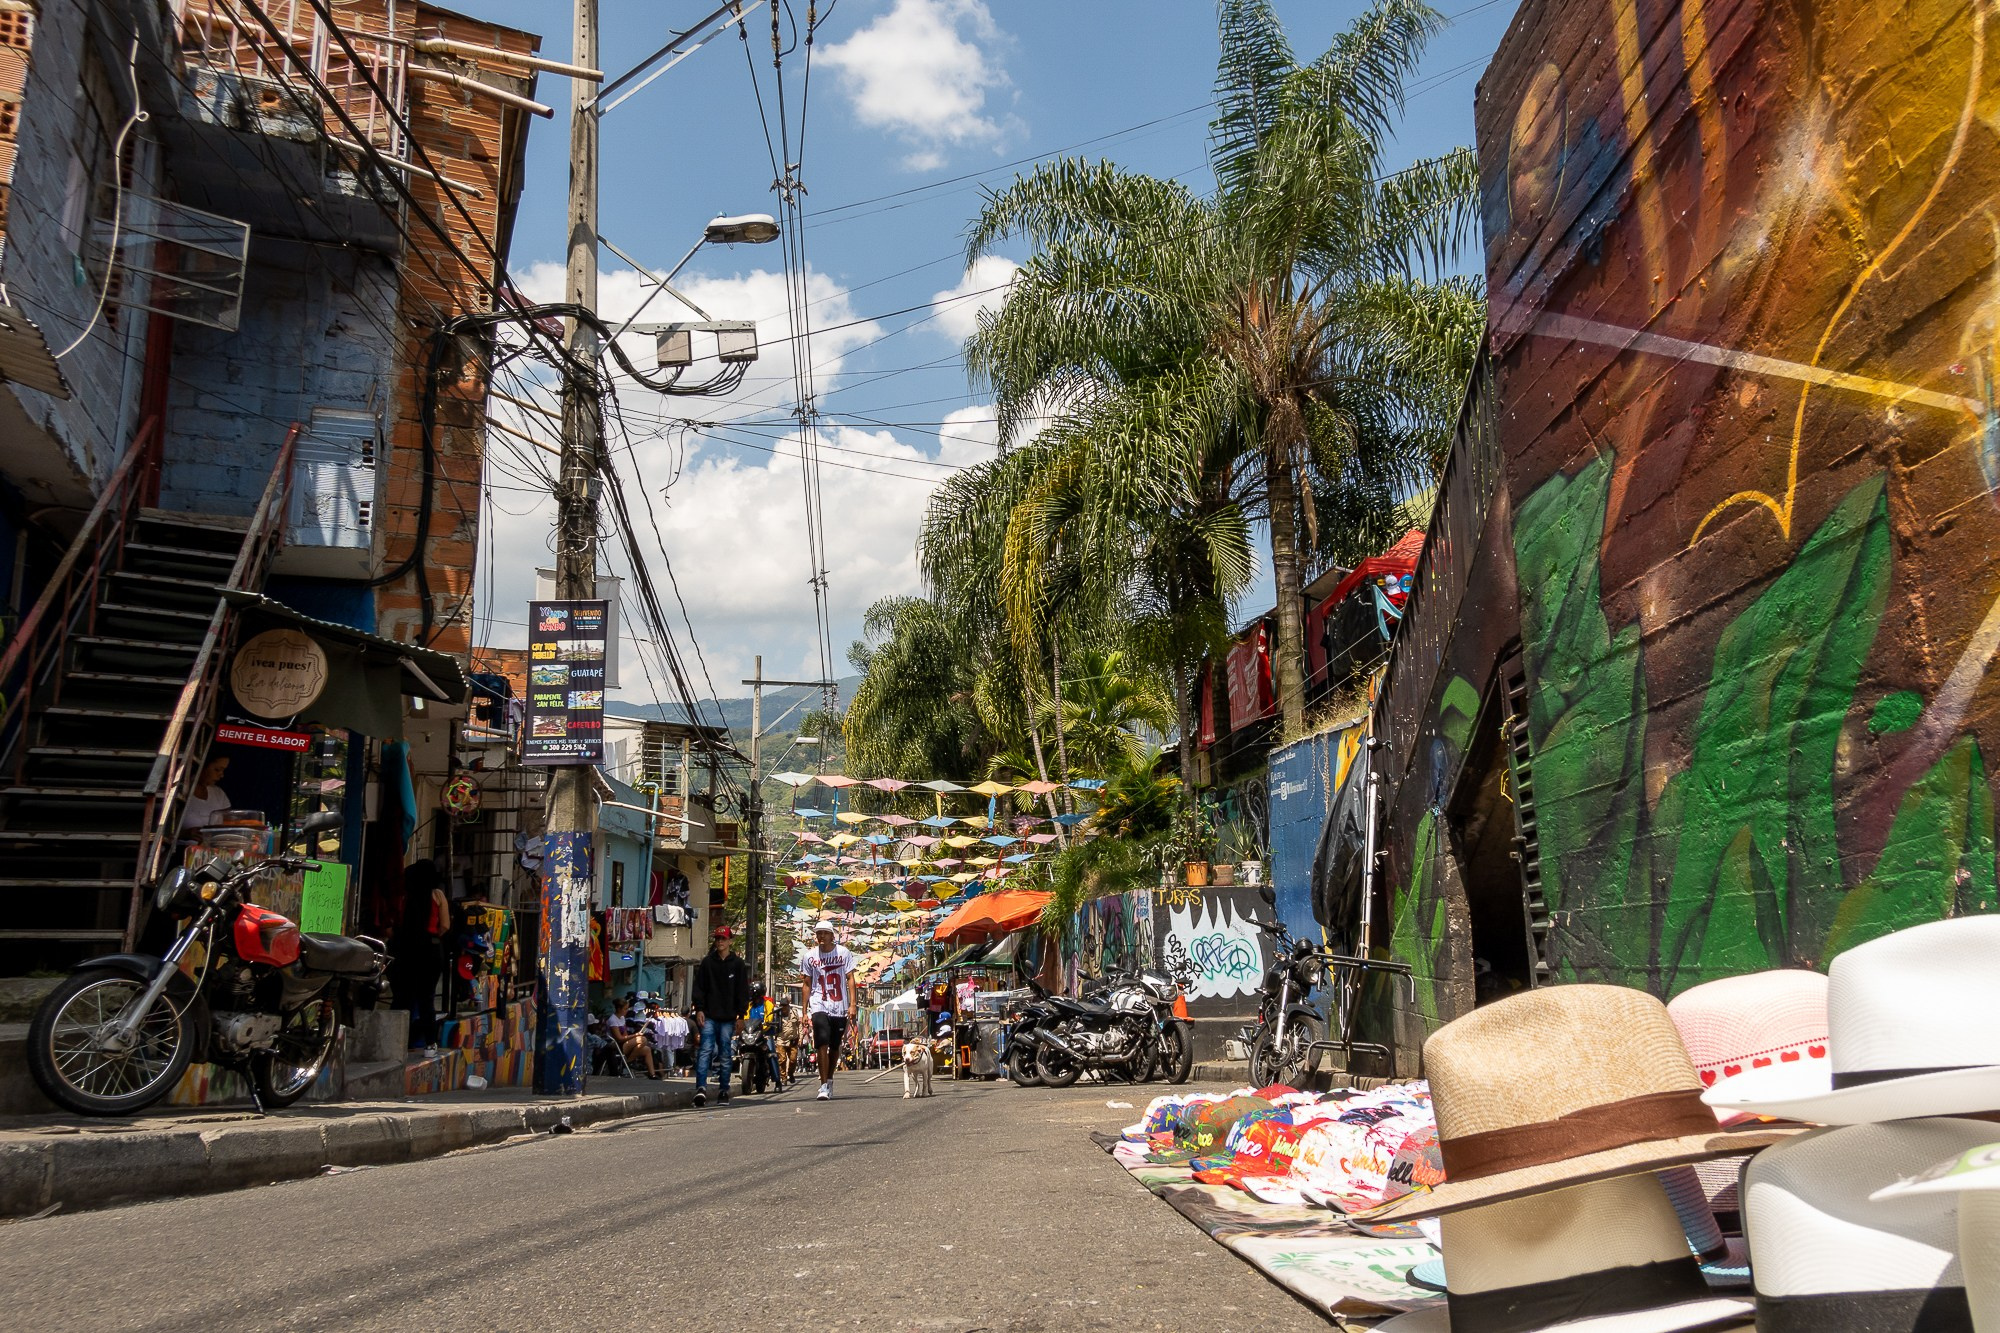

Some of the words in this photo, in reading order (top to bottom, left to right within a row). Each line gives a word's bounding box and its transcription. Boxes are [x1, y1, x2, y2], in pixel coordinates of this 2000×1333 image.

[539, 622, 567, 632] NANDO
[278, 660, 312, 672] pues!
[571, 667, 604, 678] GUATAPÉ
[533, 693, 562, 701] PARAPENTE
[536, 700, 549, 708] SAN
[549, 700, 565, 708] FÉLIX
[567, 721, 601, 729] CAFETERO
[218, 728, 254, 741] SIENTE
[255, 734, 268, 743] EL
[808, 955, 844, 969] Comuna
[818, 973, 843, 1002] 13
